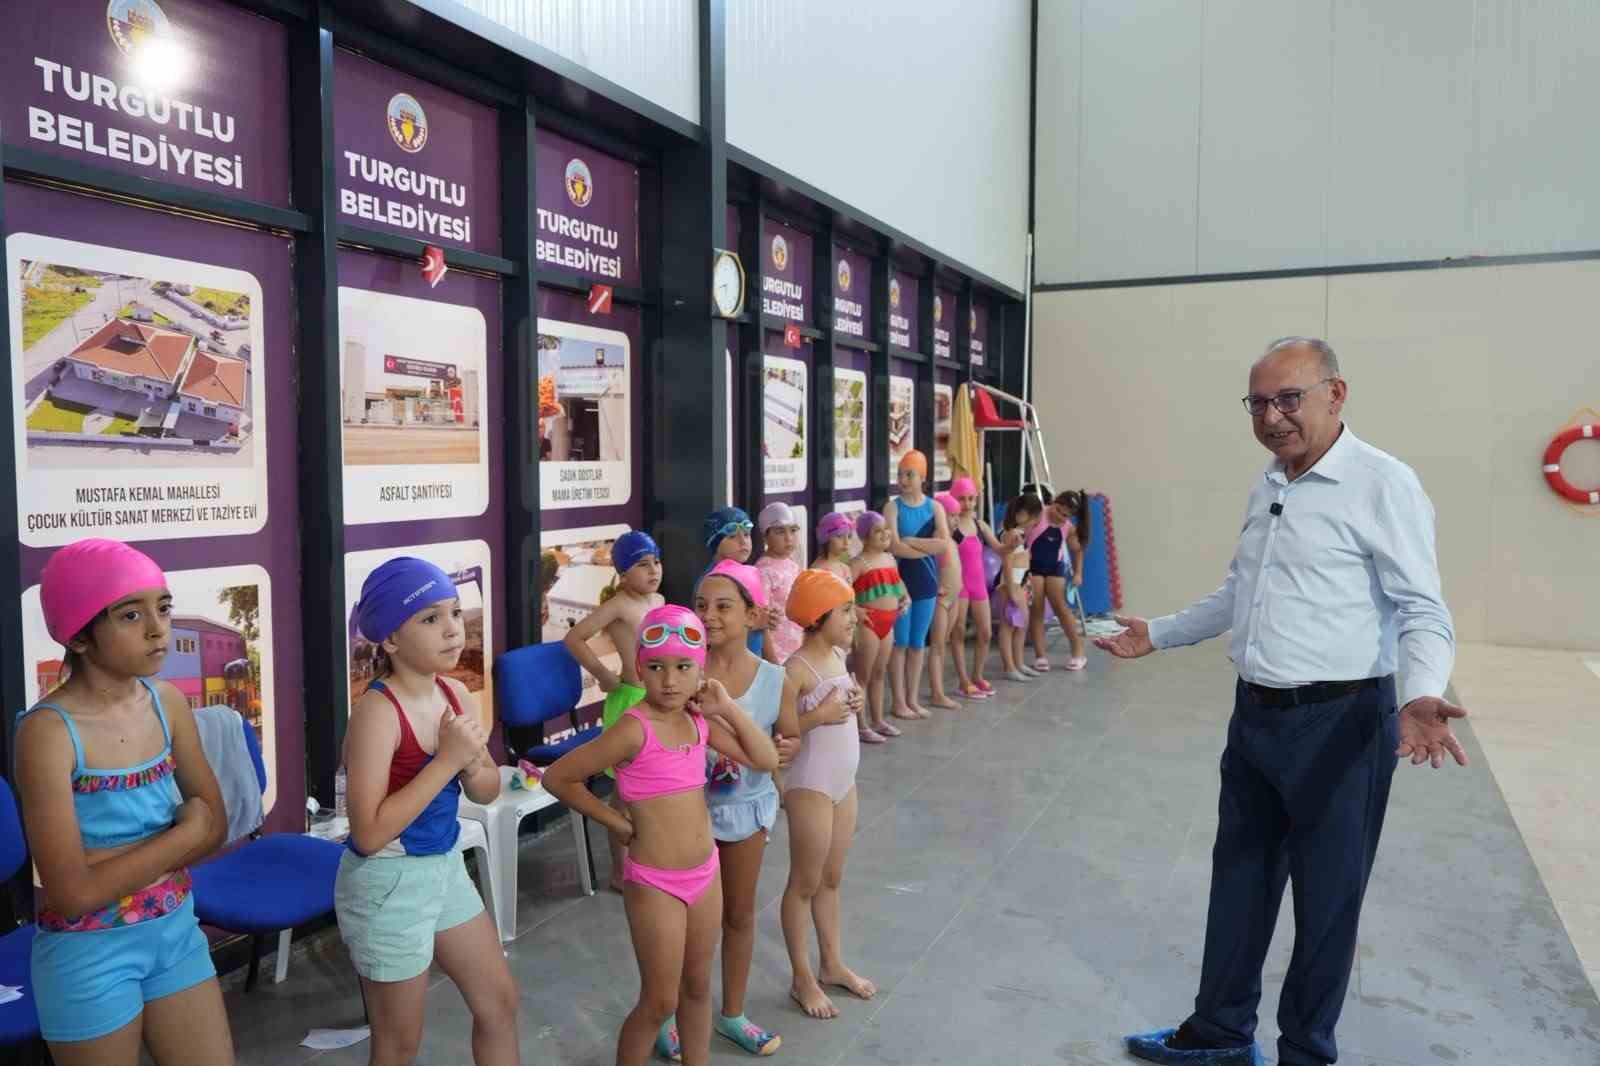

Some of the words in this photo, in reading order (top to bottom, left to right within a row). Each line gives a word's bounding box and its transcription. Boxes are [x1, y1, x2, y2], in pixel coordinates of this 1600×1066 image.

[34, 56, 235, 143] TURGUTLU
[28, 106, 243, 189] BELEDİYESİ
[344, 150, 466, 207] TURGUTLU
[340, 188, 471, 243] BELEDİYESİ
[536, 208, 618, 250] TURGUTLU
[535, 239, 621, 279] BELEDİYESİ
[76, 487, 127, 503] MUSTAFA
[129, 485, 164, 502] KEMAL
[167, 482, 220, 501] MAHALLESİ
[379, 485, 410, 502] ASFALT
[411, 480, 453, 503] ŞANTİYESİ
[28, 512, 68, 532] ÇOCUK
[70, 508, 113, 528] KÜLTÜR
[115, 509, 149, 526] SANAT
[151, 506, 196, 524] MERKEZİ
[197, 507, 209, 521] VE
[211, 503, 241, 520] TAZİYE
[243, 502, 258, 519] EVİ
